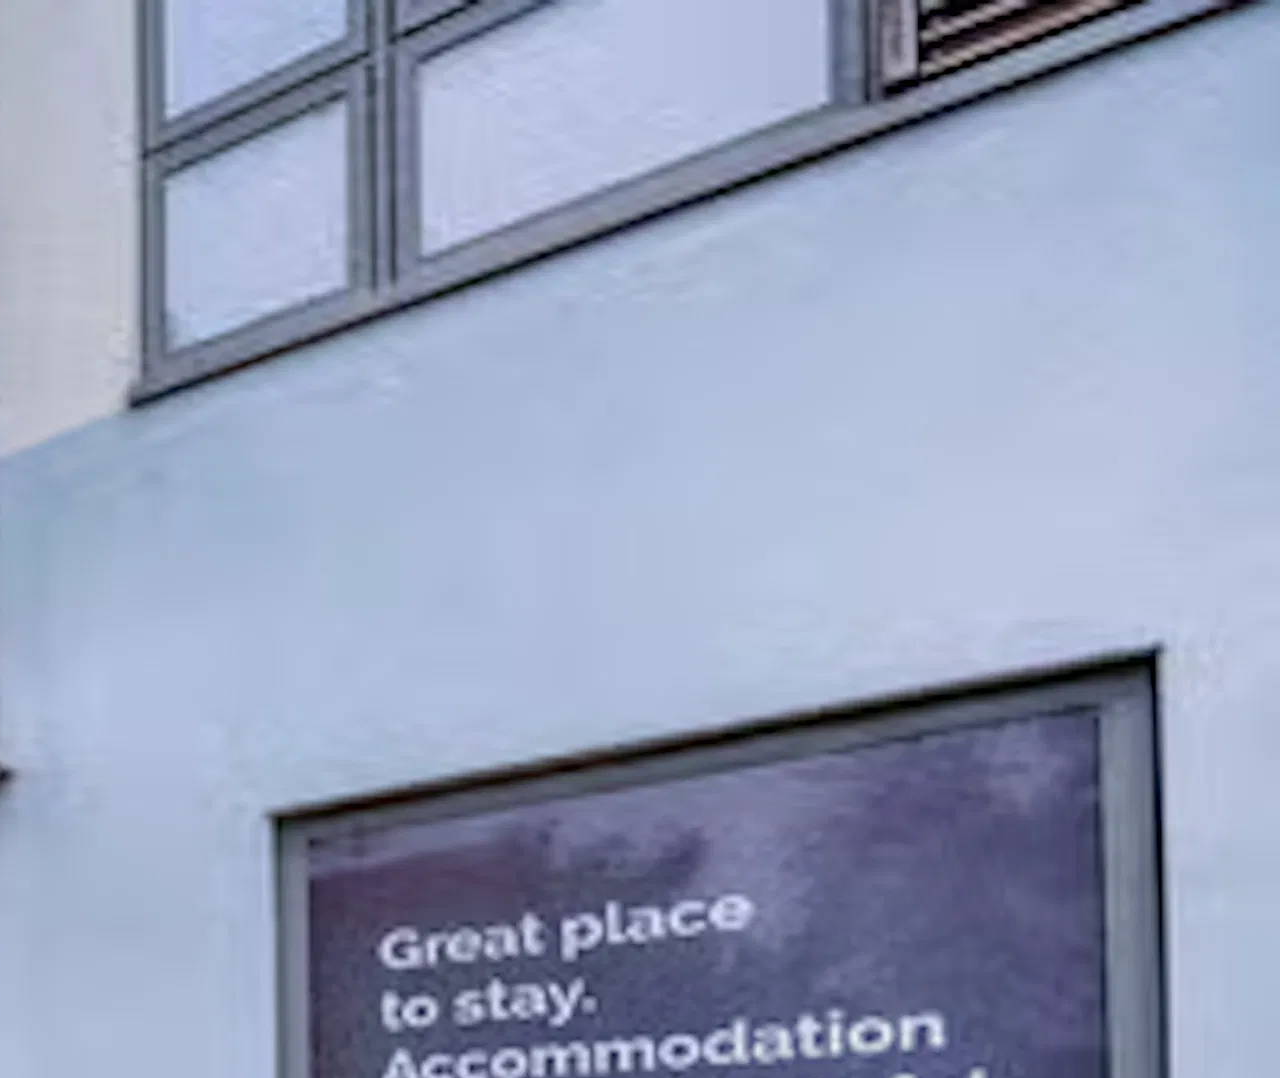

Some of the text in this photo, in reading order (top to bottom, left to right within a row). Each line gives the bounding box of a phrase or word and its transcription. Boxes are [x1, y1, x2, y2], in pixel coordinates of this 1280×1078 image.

[378, 894, 757, 970] Great place
[380, 977, 598, 1031] to stay.
